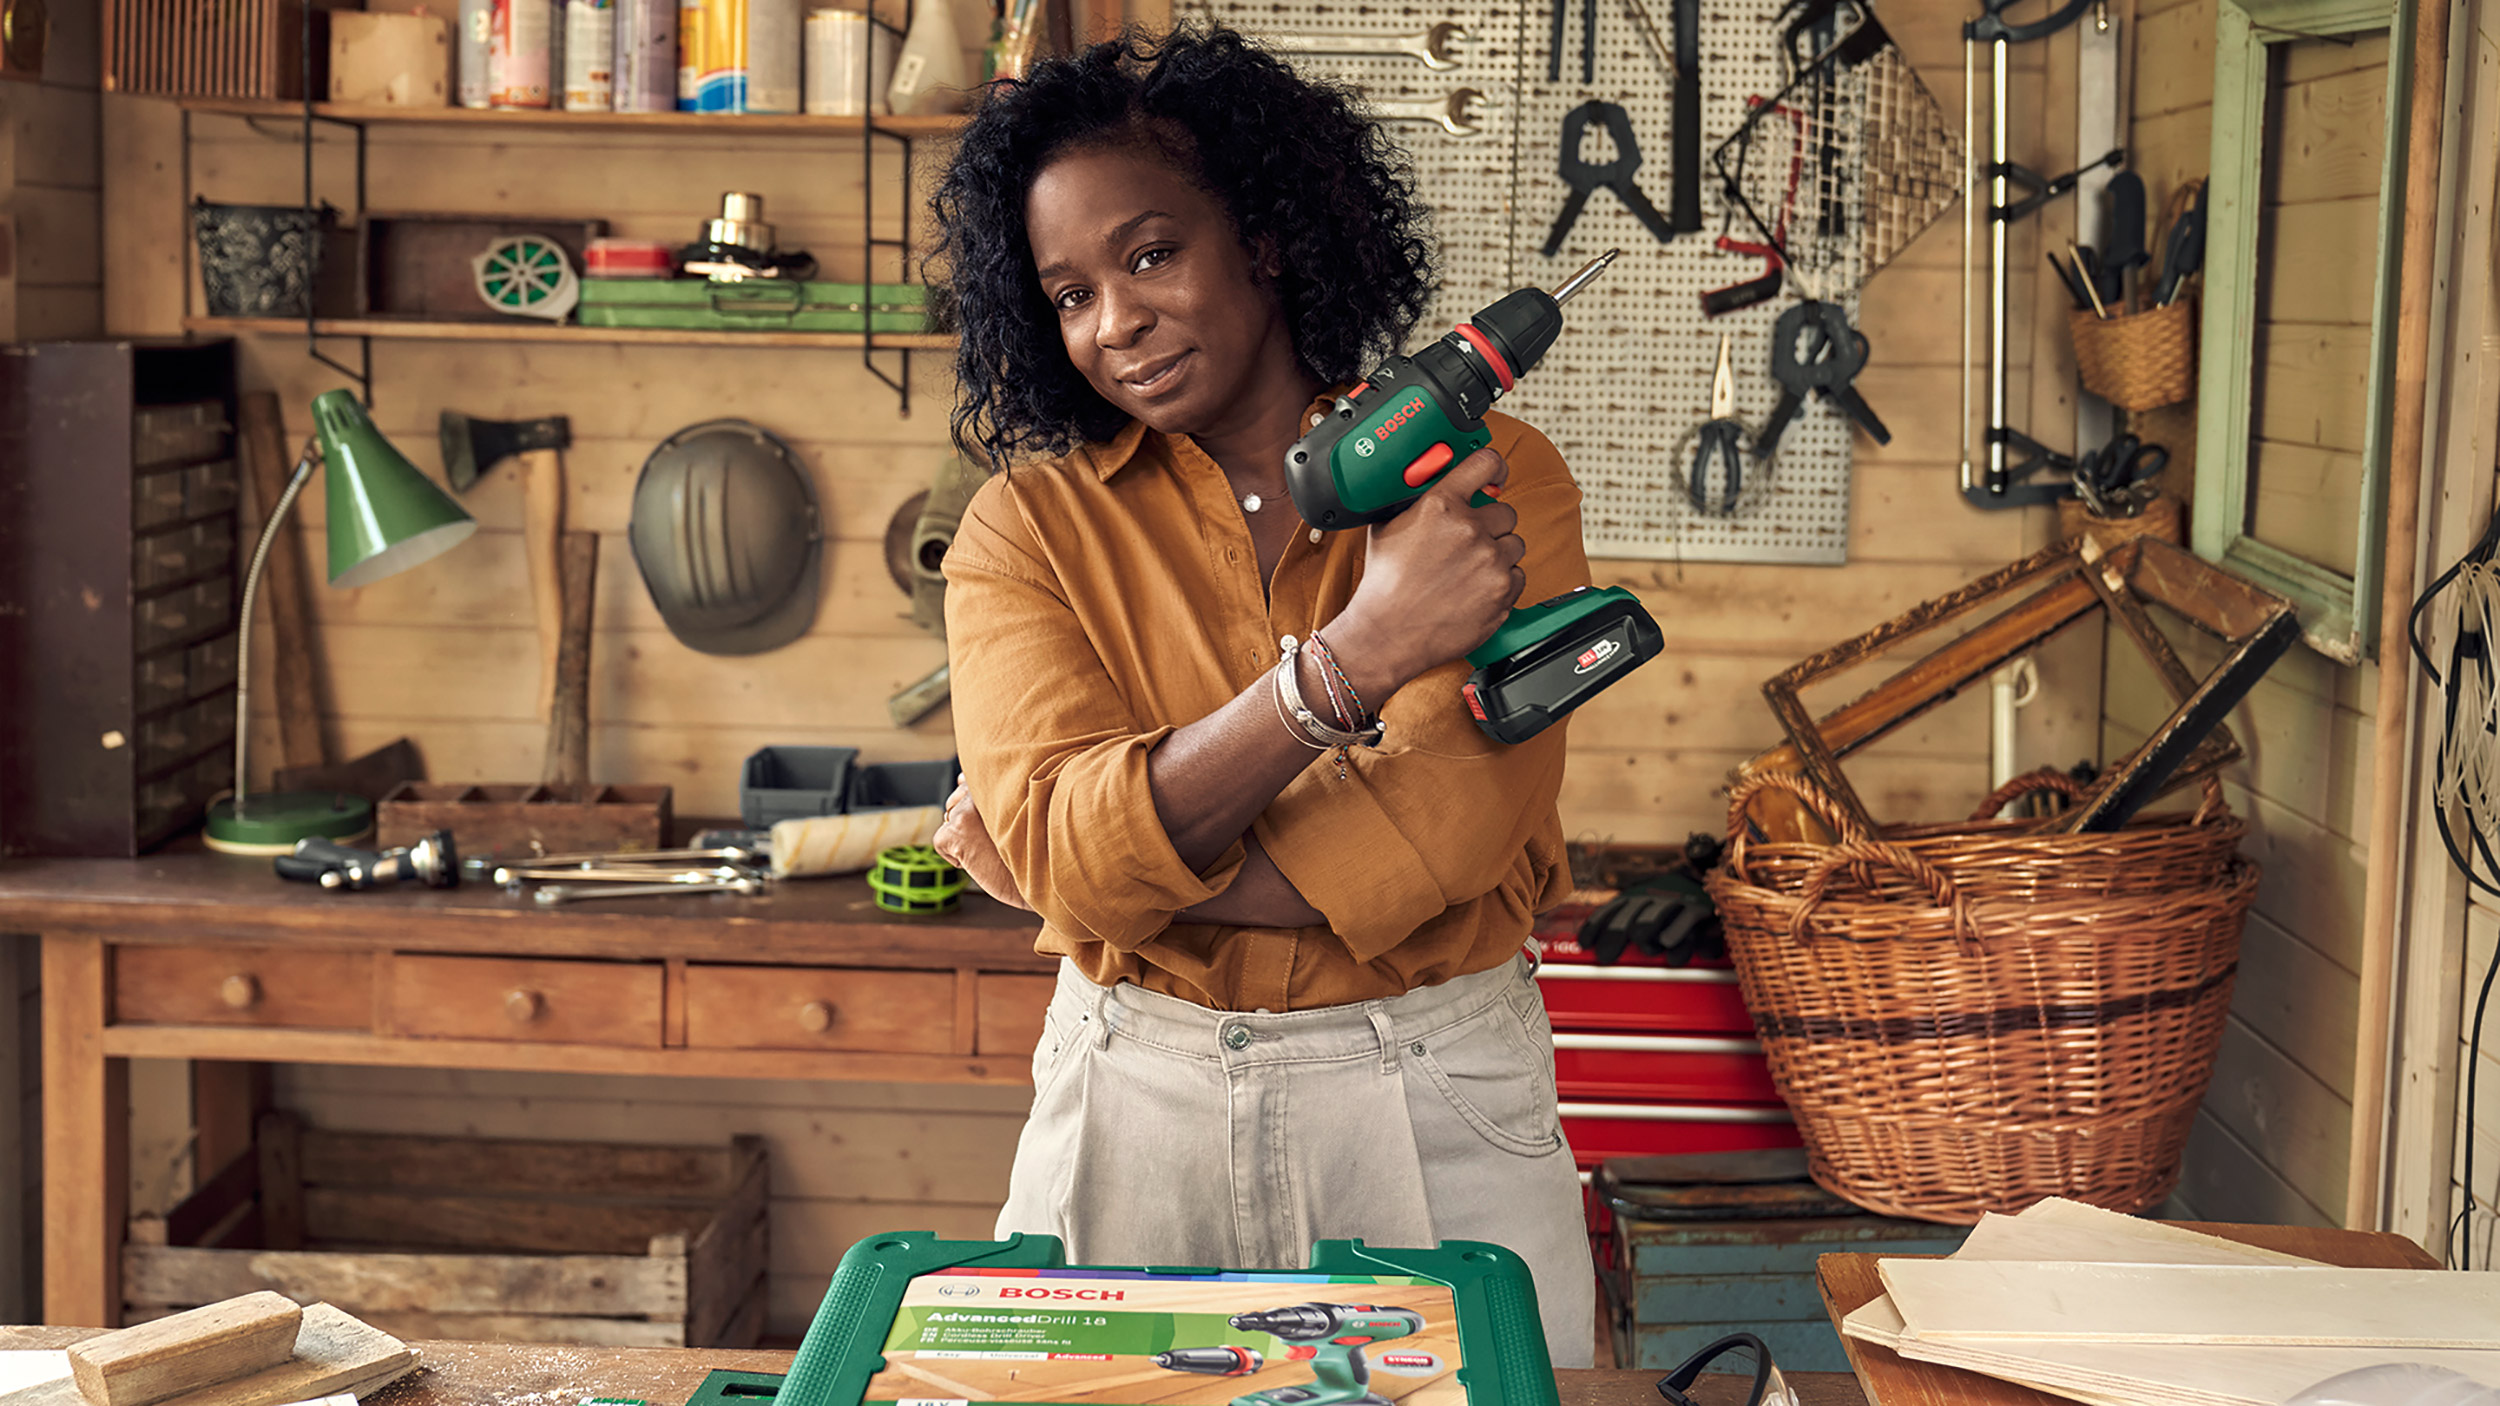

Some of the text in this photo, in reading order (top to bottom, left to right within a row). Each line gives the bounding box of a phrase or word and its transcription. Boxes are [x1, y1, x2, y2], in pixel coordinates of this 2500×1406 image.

[1374, 396, 1426, 441] BOSCH
[999, 1287, 1125, 1301] BOSCH
[926, 1312, 1107, 1326] AdvancedDrill 18
[1054, 1353, 1106, 1361] Advanced
